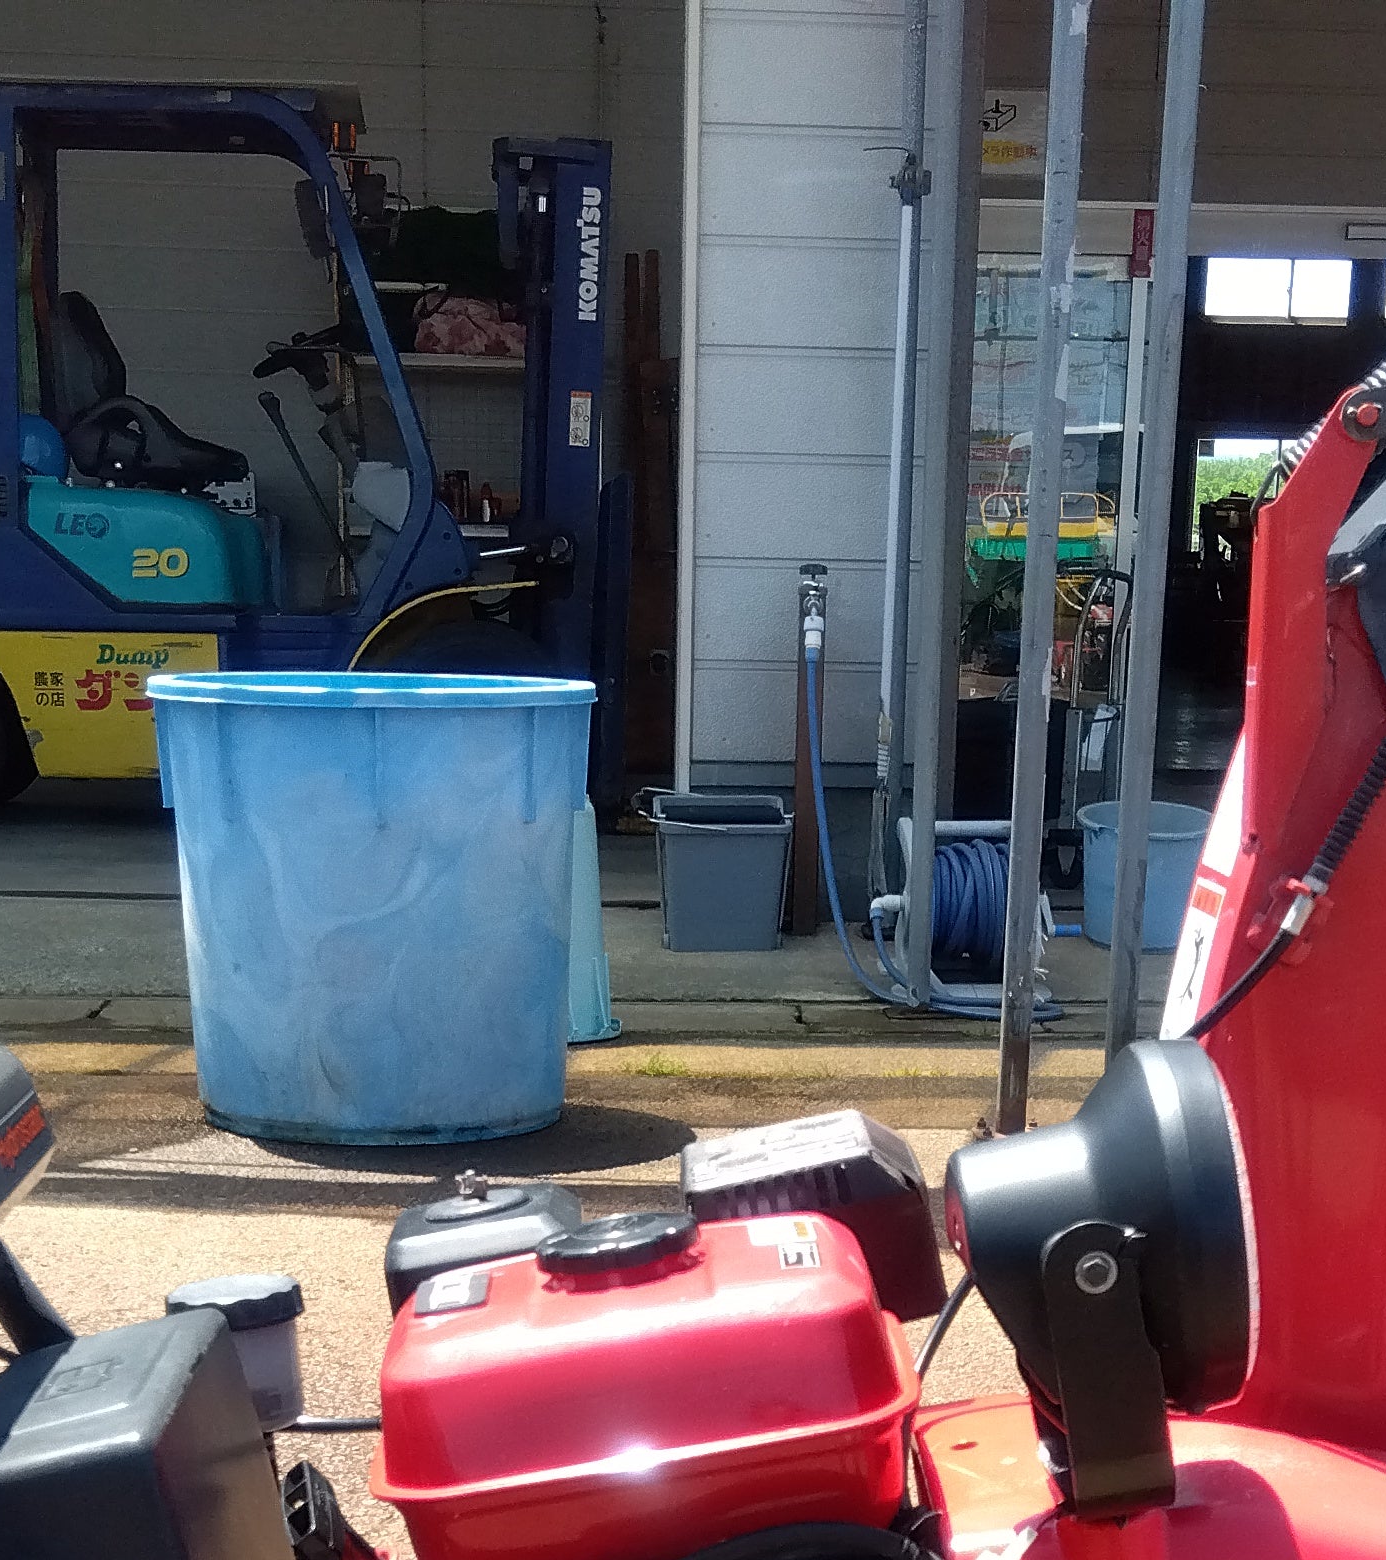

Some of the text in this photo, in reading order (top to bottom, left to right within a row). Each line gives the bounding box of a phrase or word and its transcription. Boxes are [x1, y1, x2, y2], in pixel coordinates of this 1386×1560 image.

[576, 186, 602, 321] KOMATSU
[54, 512, 110, 539] LEO
[131, 547, 190, 578] 20
[96, 643, 170, 670] Dump
[34, 671, 64, 687] 農家
[35, 692, 65, 707] の店
